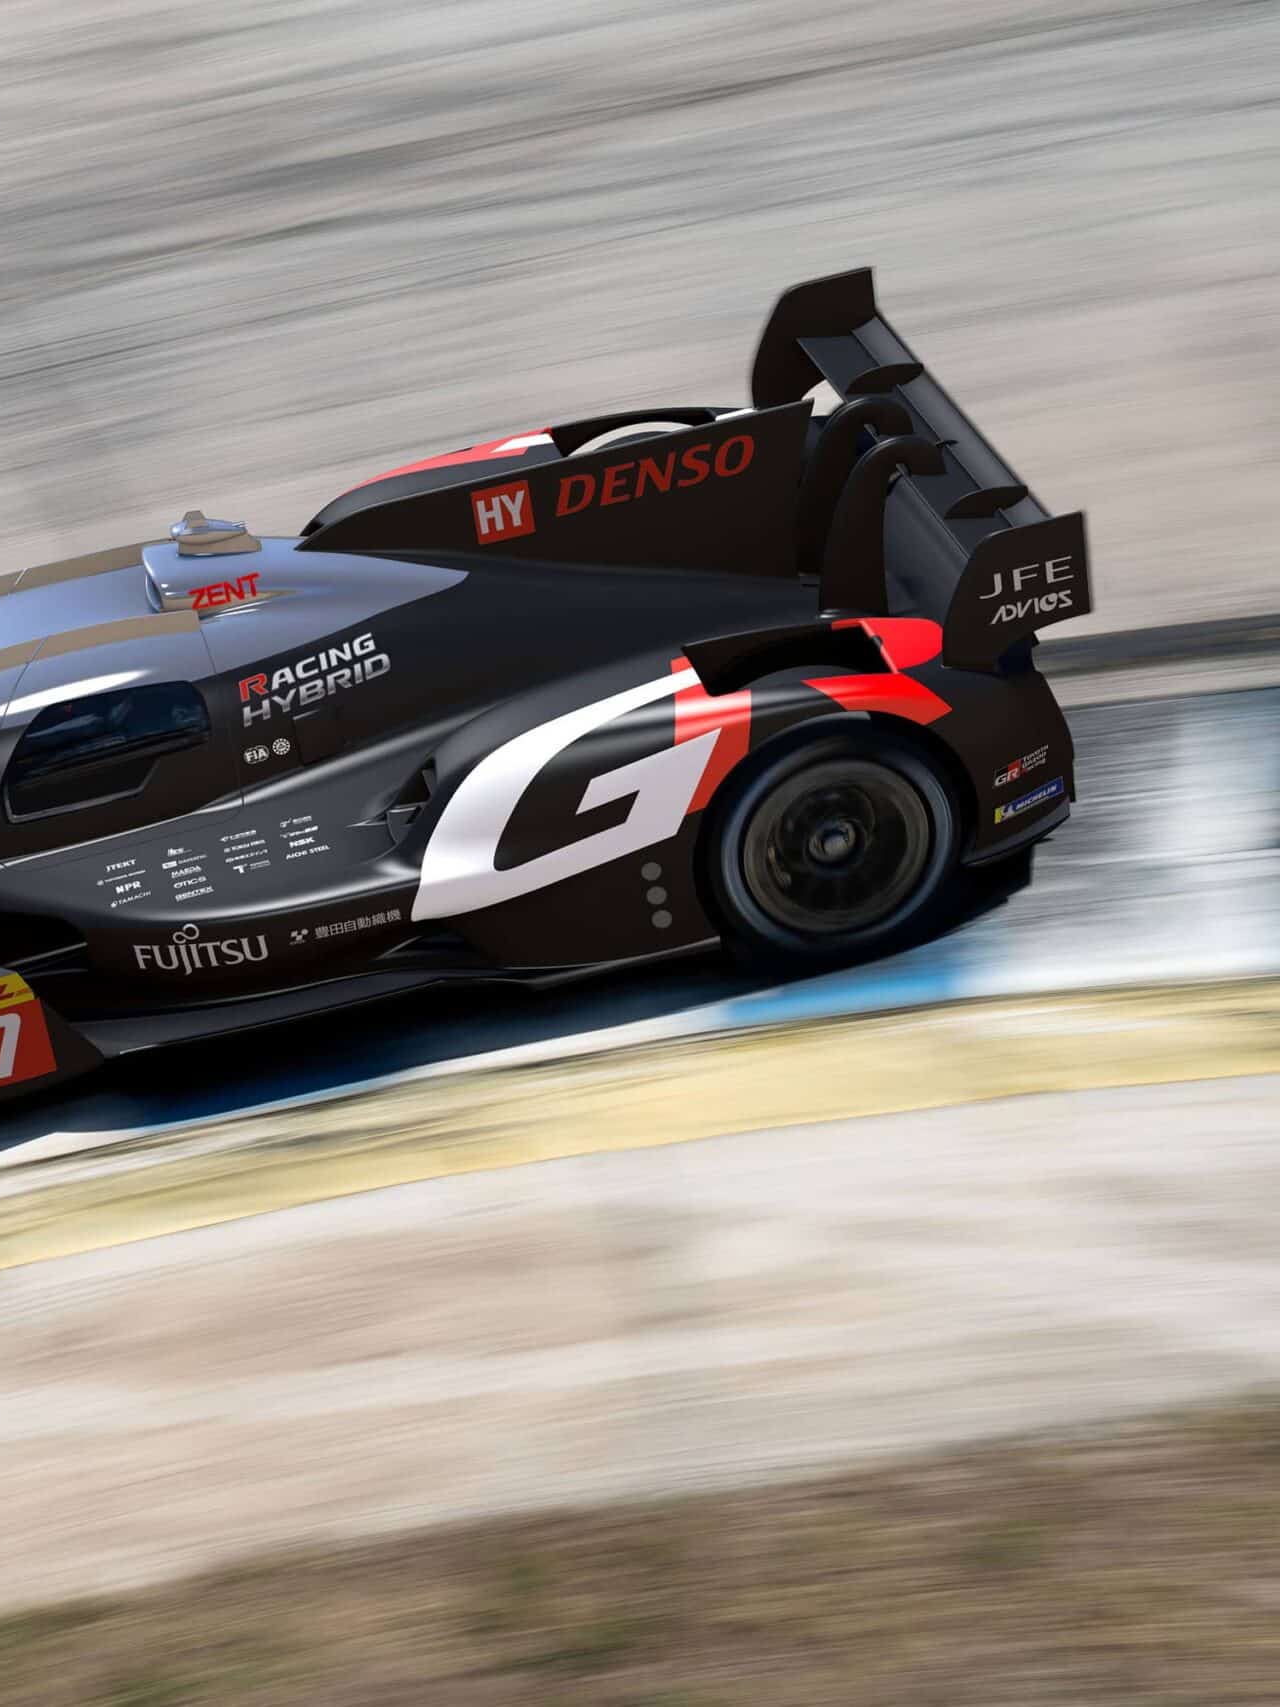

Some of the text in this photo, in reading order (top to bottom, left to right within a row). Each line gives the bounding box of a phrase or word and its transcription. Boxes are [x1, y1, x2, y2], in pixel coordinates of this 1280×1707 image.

[556, 435, 755, 517] DENSO
[476, 490, 525, 535] HY
[188, 571, 260, 610] ZENT
[979, 556, 1074, 600] JFE
[990, 590, 1073, 625] ADVICS
[239, 632, 376, 702] RACING
[242, 653, 391, 728] HYBRID
[245, 746, 269, 764] FIA
[995, 768, 1020, 787] GR
[1015, 783, 1058, 810] MICHELIN
[106, 858, 137, 873] JTEKT
[115, 880, 142, 895] NPR
[133, 934, 269, 976] FUJITSU
